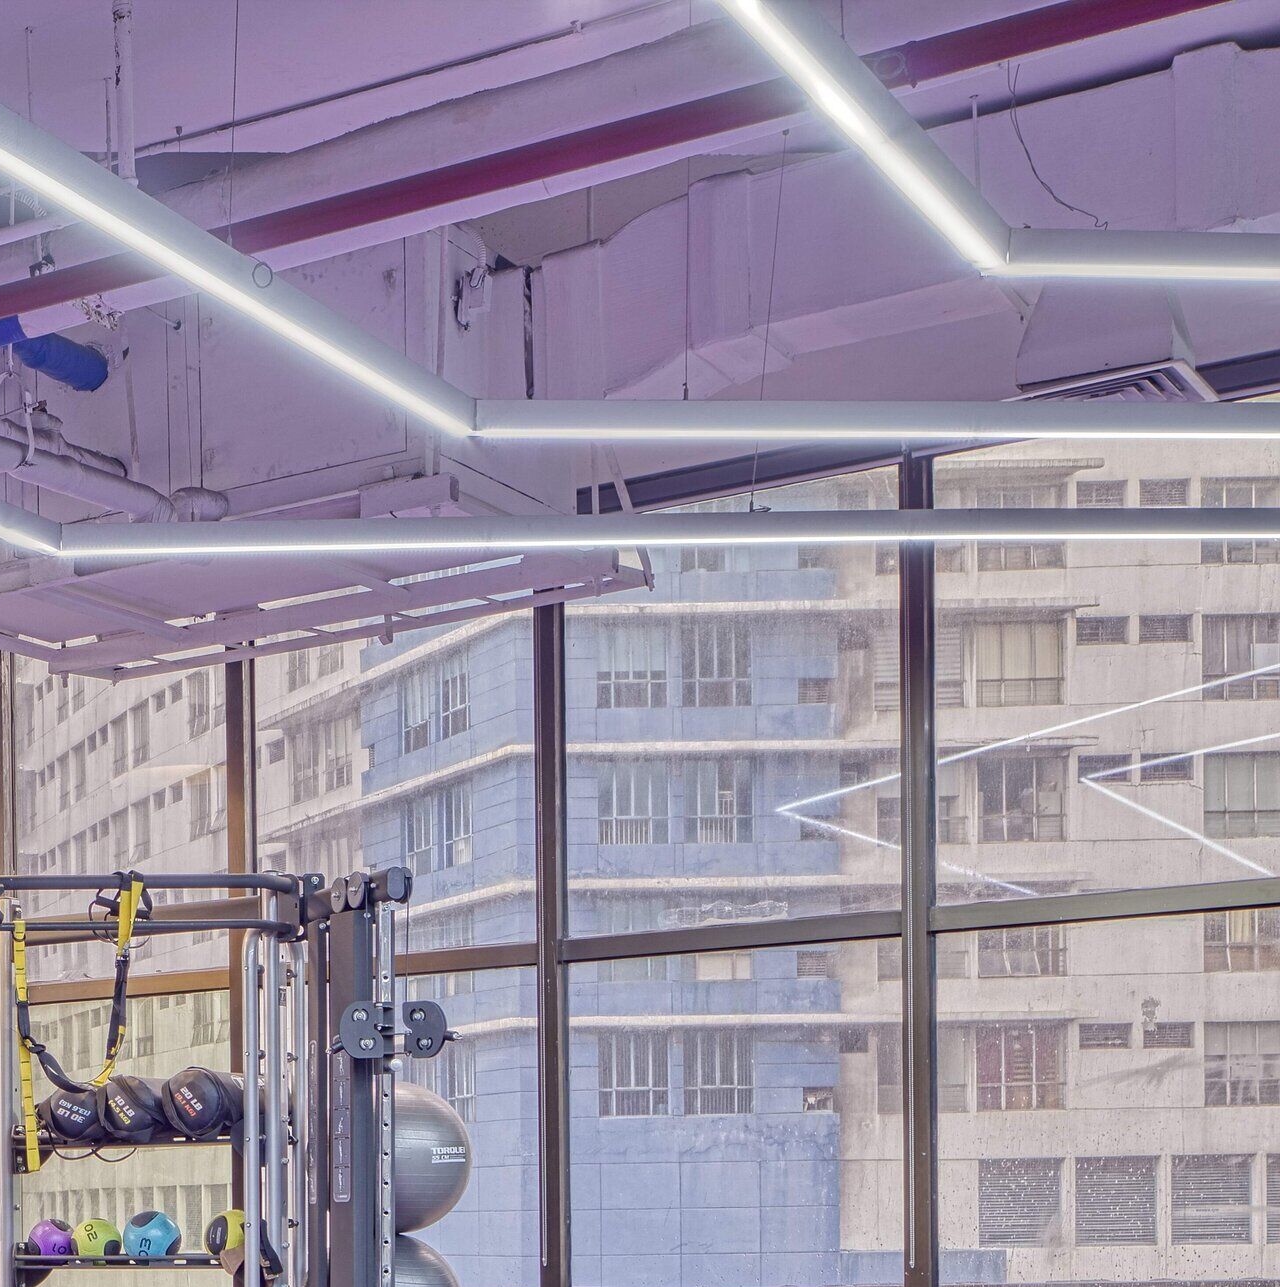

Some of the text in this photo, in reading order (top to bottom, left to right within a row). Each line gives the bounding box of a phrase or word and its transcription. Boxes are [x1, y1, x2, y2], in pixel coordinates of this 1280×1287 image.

[114, 1095, 135, 1118] 10 LB
[179, 1086, 203, 1112] 20 LB
[56, 1107, 86, 1124] 30 LB
